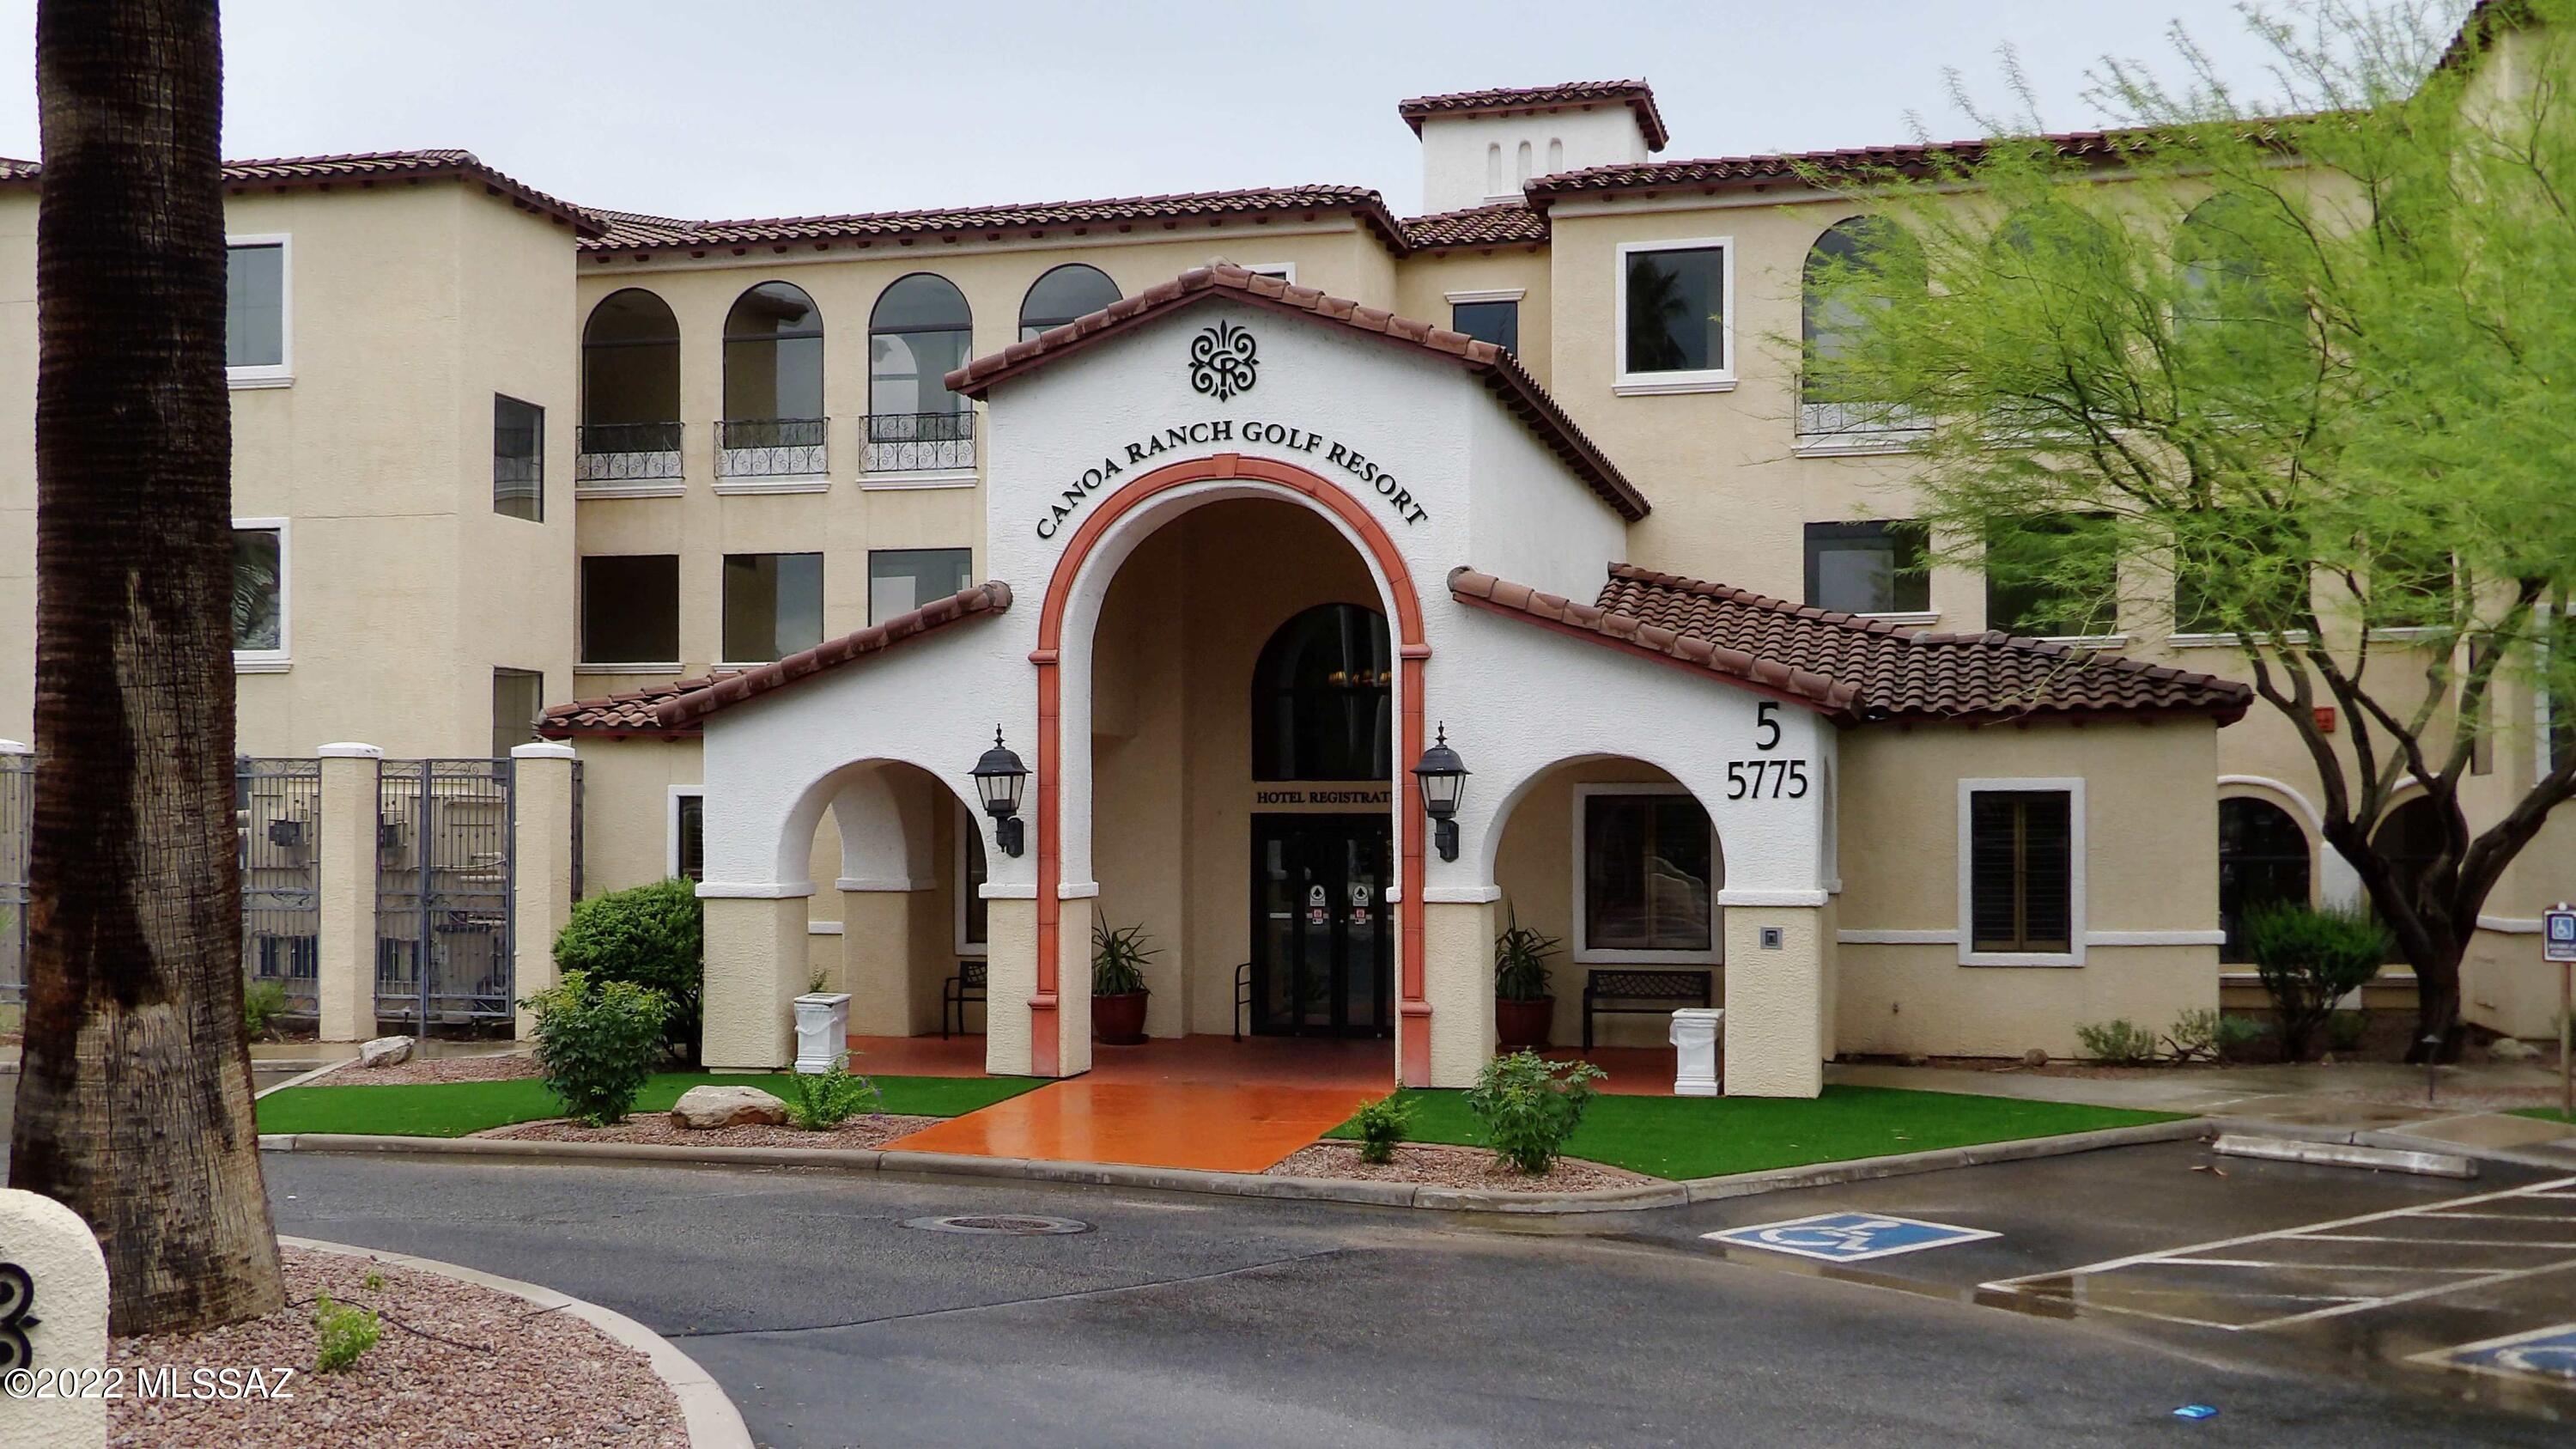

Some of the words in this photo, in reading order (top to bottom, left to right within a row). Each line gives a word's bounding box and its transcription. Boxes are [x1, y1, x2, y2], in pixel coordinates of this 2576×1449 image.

[1037, 458, 1123, 539] CANOA
[1125, 421, 1232, 465] RANCH
[1242, 421, 1322, 453] GOLF
[1326, 441, 1429, 527] RESORT
[1756, 702, 1780, 751] 5
[1257, 792, 1305, 804] HOTEL
[1309, 791, 1392, 804] REGISTRAT
[1728, 760, 1807, 800] 5775
